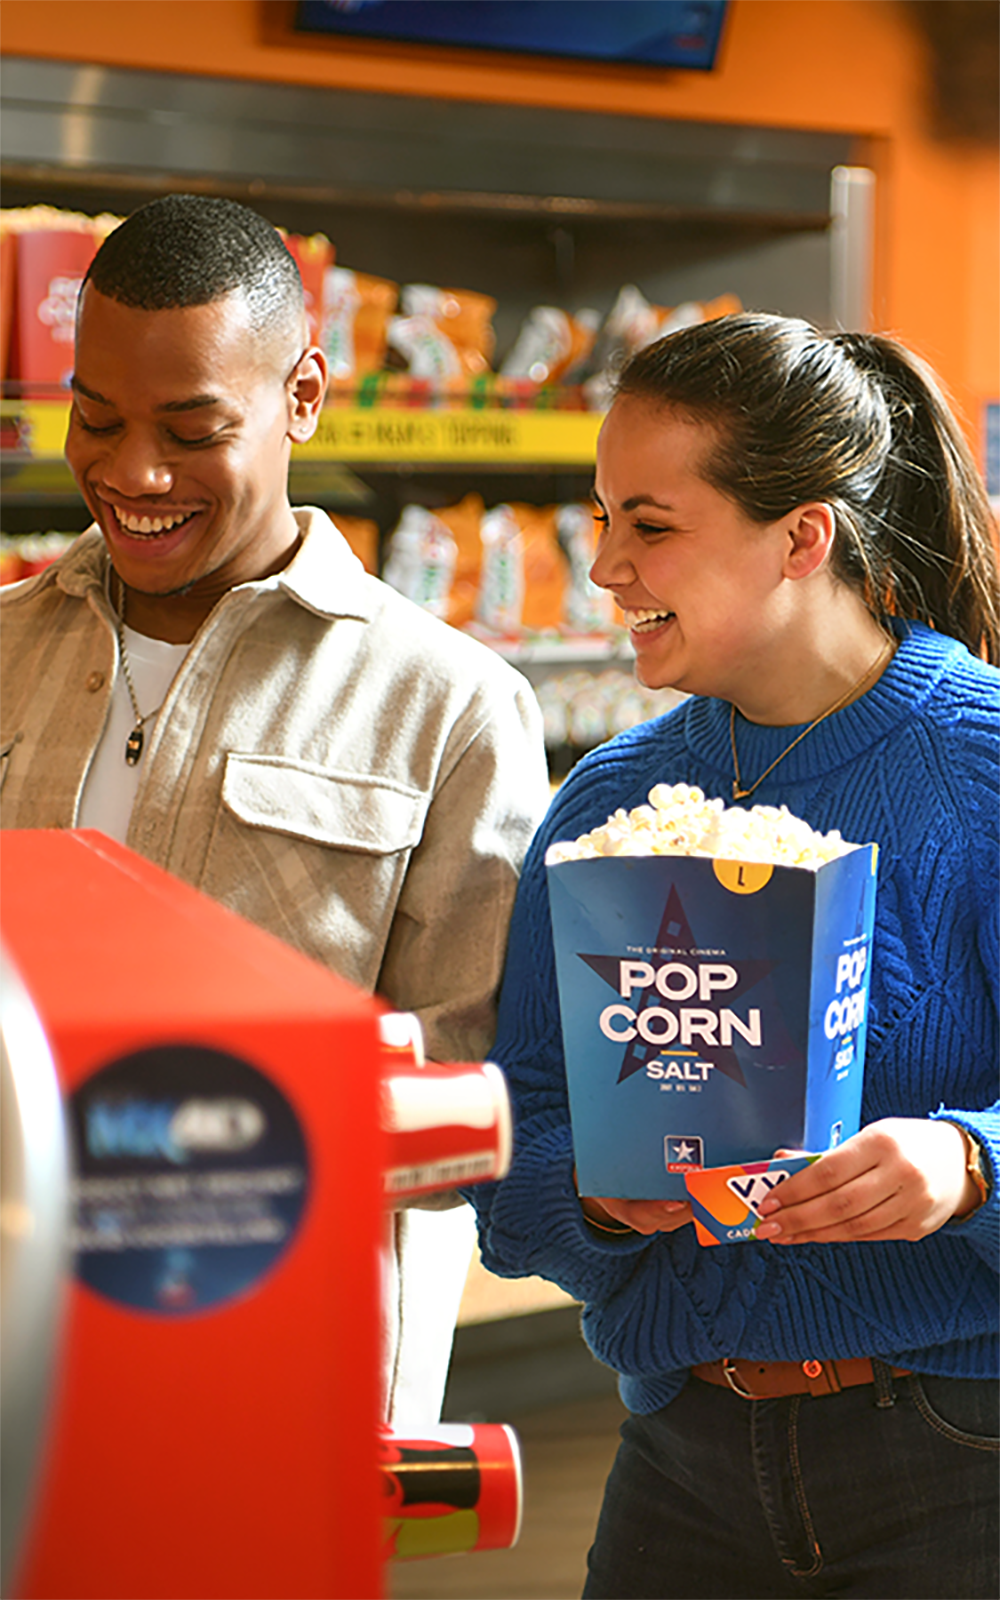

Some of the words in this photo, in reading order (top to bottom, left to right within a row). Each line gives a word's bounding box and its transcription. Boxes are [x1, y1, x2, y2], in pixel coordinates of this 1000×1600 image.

[738, 866, 745, 886] L
[626, 945, 643, 954] THE
[690, 948, 726, 956] CINEMA
[620, 960, 738, 1000] POP
[599, 1004, 762, 1046] CORN
[646, 1060, 714, 1080] SALT
